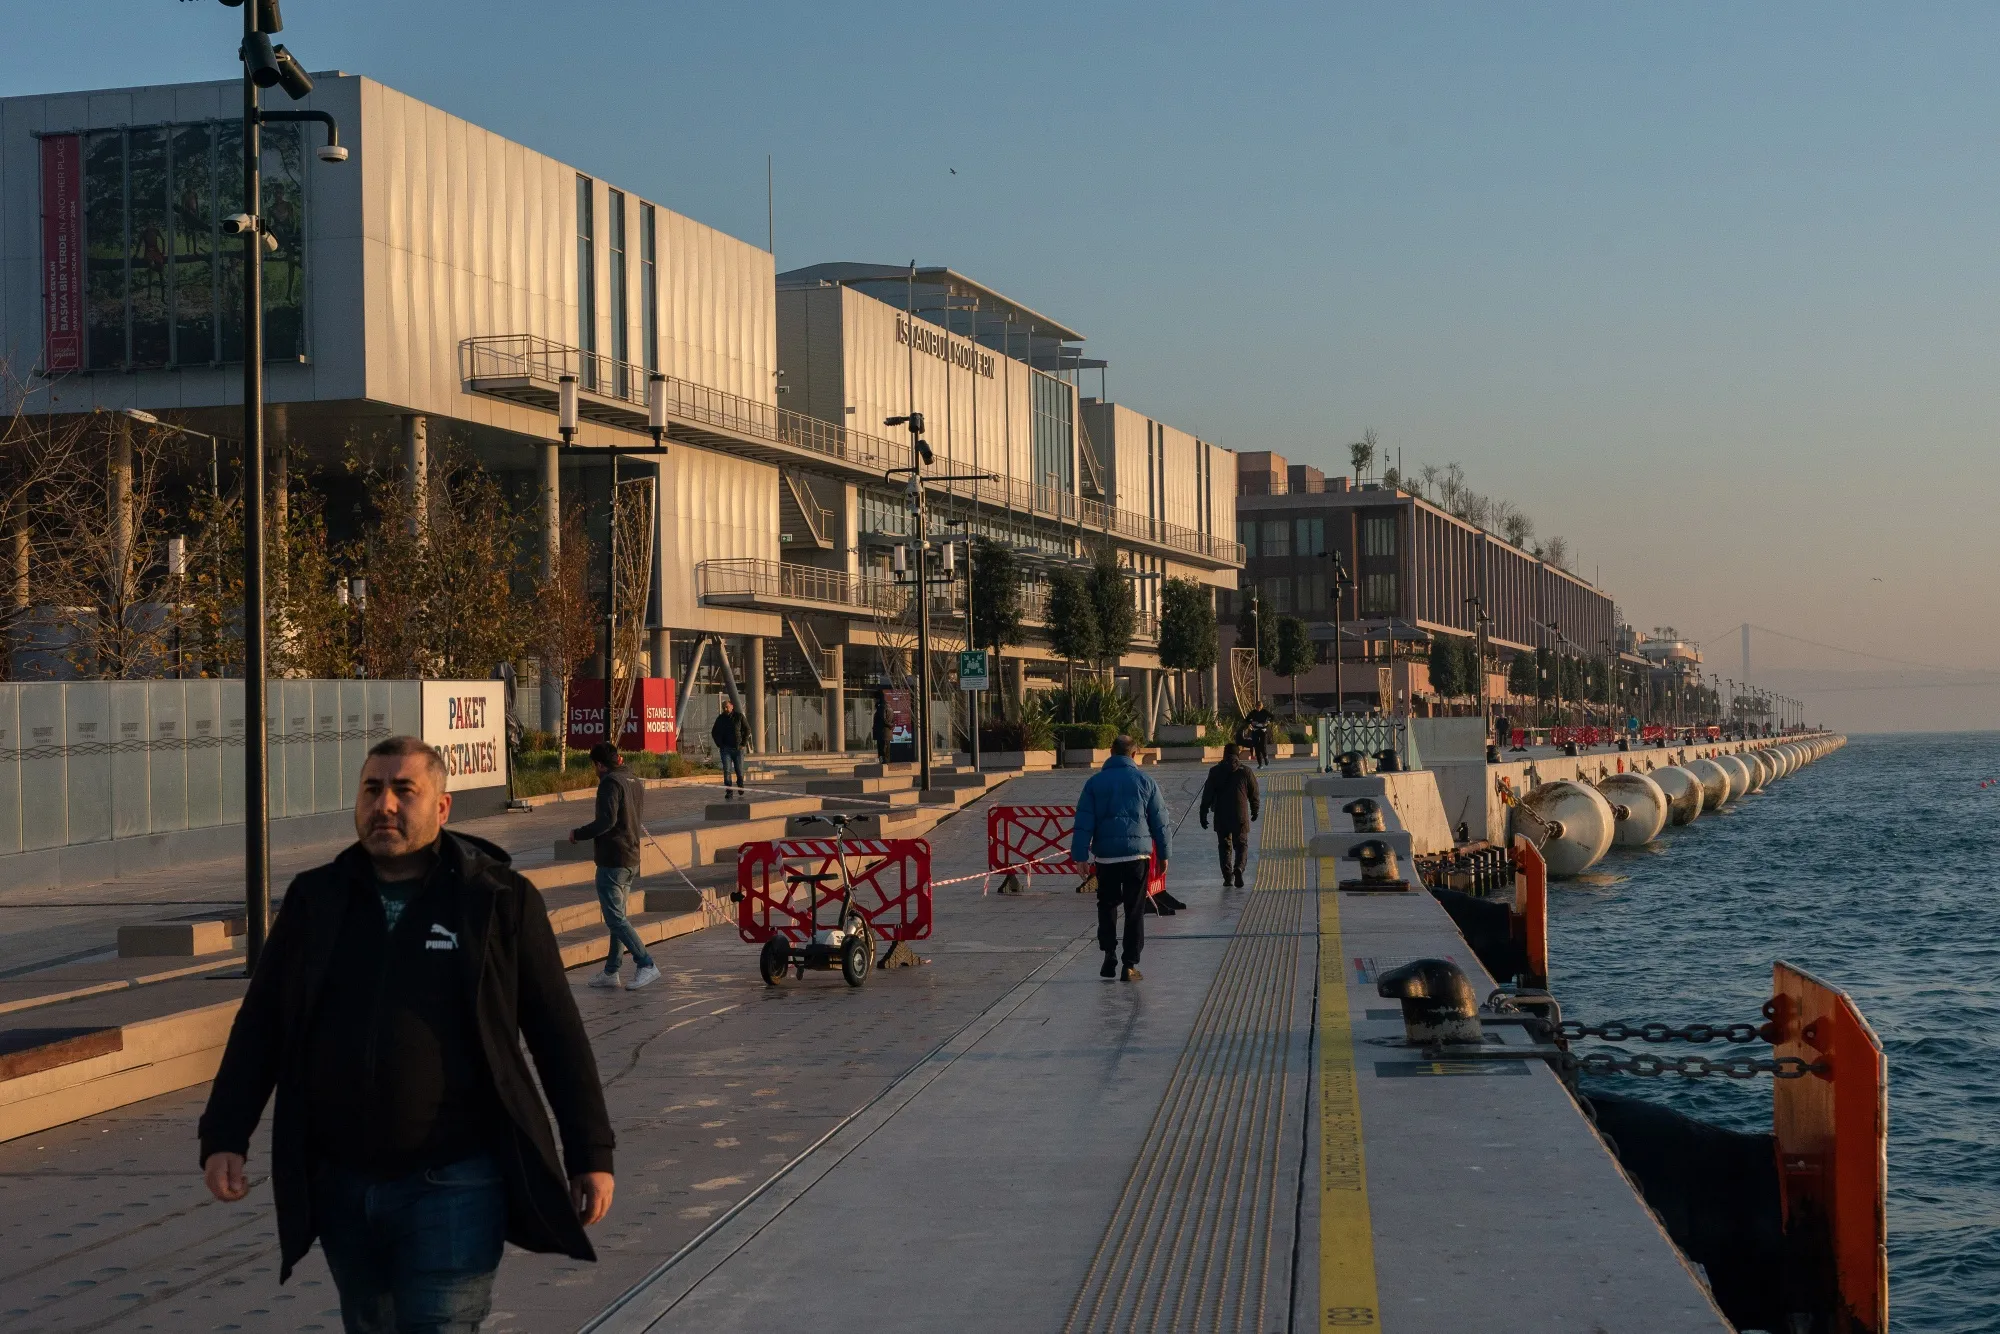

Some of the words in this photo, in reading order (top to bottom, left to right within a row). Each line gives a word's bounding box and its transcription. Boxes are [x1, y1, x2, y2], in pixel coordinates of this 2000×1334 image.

[57, 137, 65, 170] PLACE
[58, 172, 66, 220] ANOTHER
[58, 222, 66, 232] IN
[59, 234, 68, 271] YERDE
[58, 274, 68, 292] BİR
[60, 294, 70, 330] BAŞKA
[448, 696, 486, 730] PAKET
[646, 704, 674, 719] İSTANBUL
[571, 722, 638, 734] MODN
[646, 721, 674, 732] MODERN
[425, 940, 453, 950] PUMA
